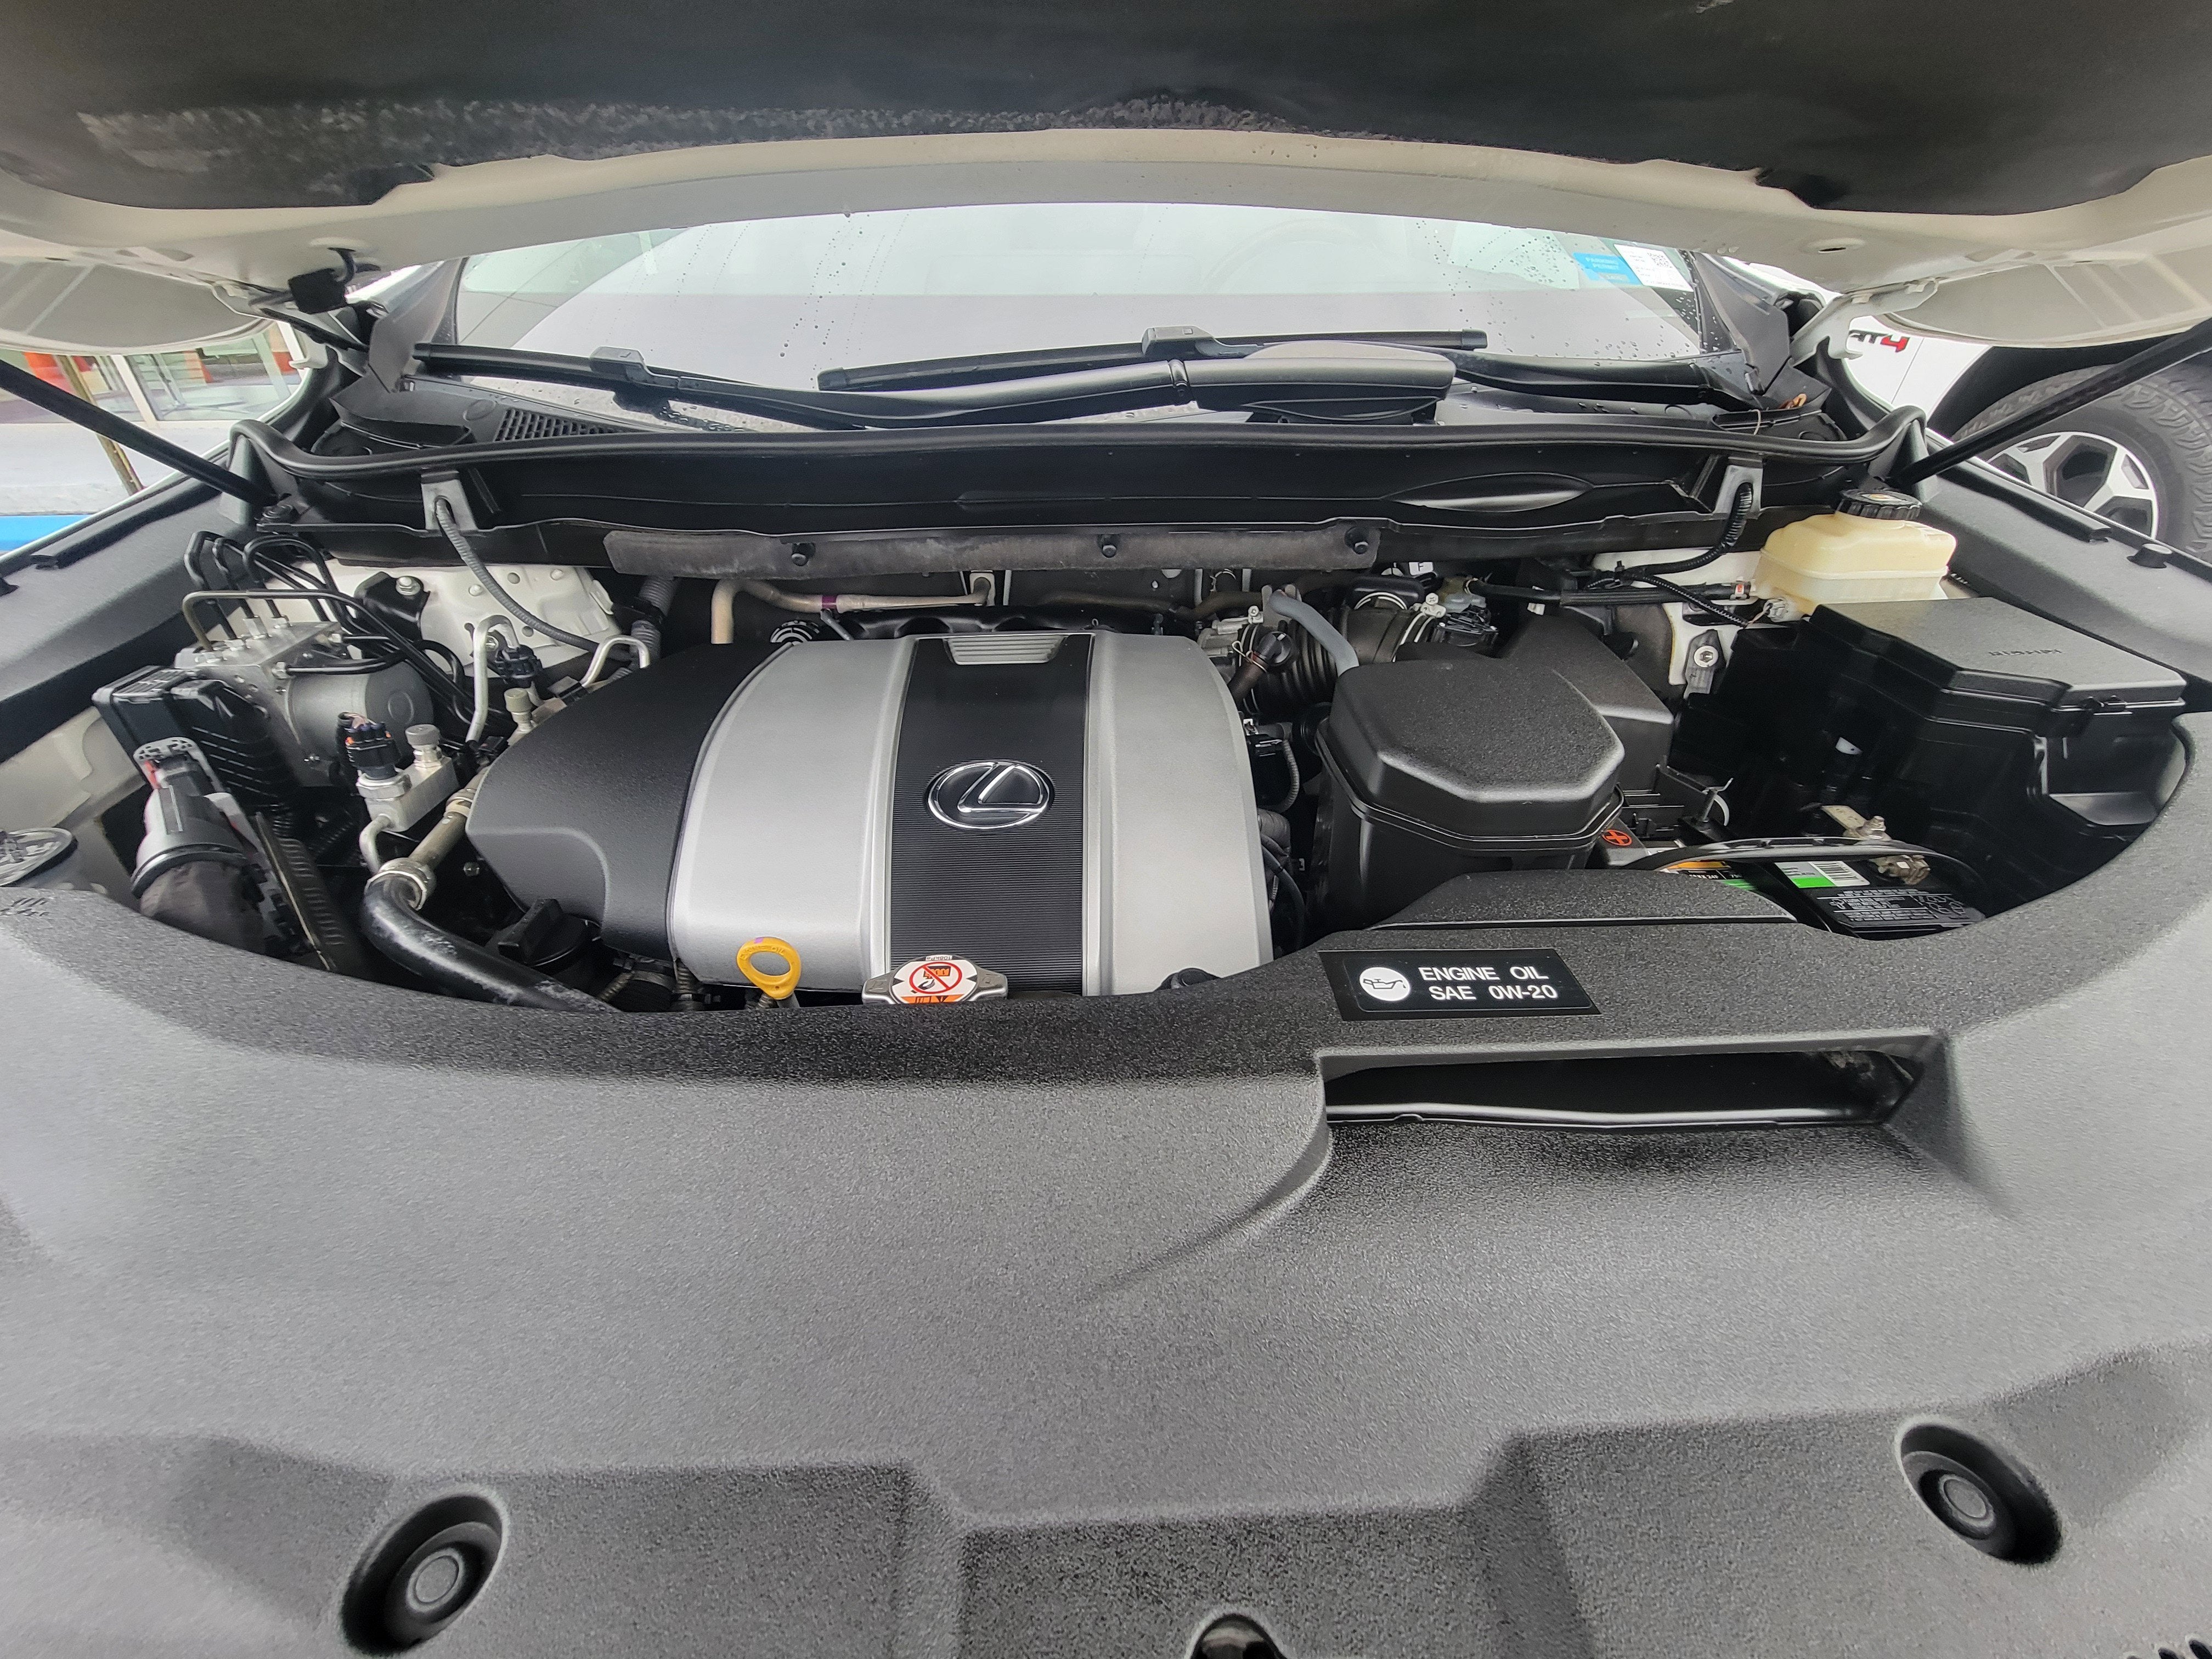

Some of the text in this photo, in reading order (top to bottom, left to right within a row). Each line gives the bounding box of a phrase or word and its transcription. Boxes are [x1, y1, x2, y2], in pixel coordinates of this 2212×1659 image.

[1418, 561, 1424, 571] F
[771, 946, 785, 956] OIL
[1418, 966, 1549, 981] ENGINE OIL
[1428, 984, 1559, 1000] SAE 0W-20
